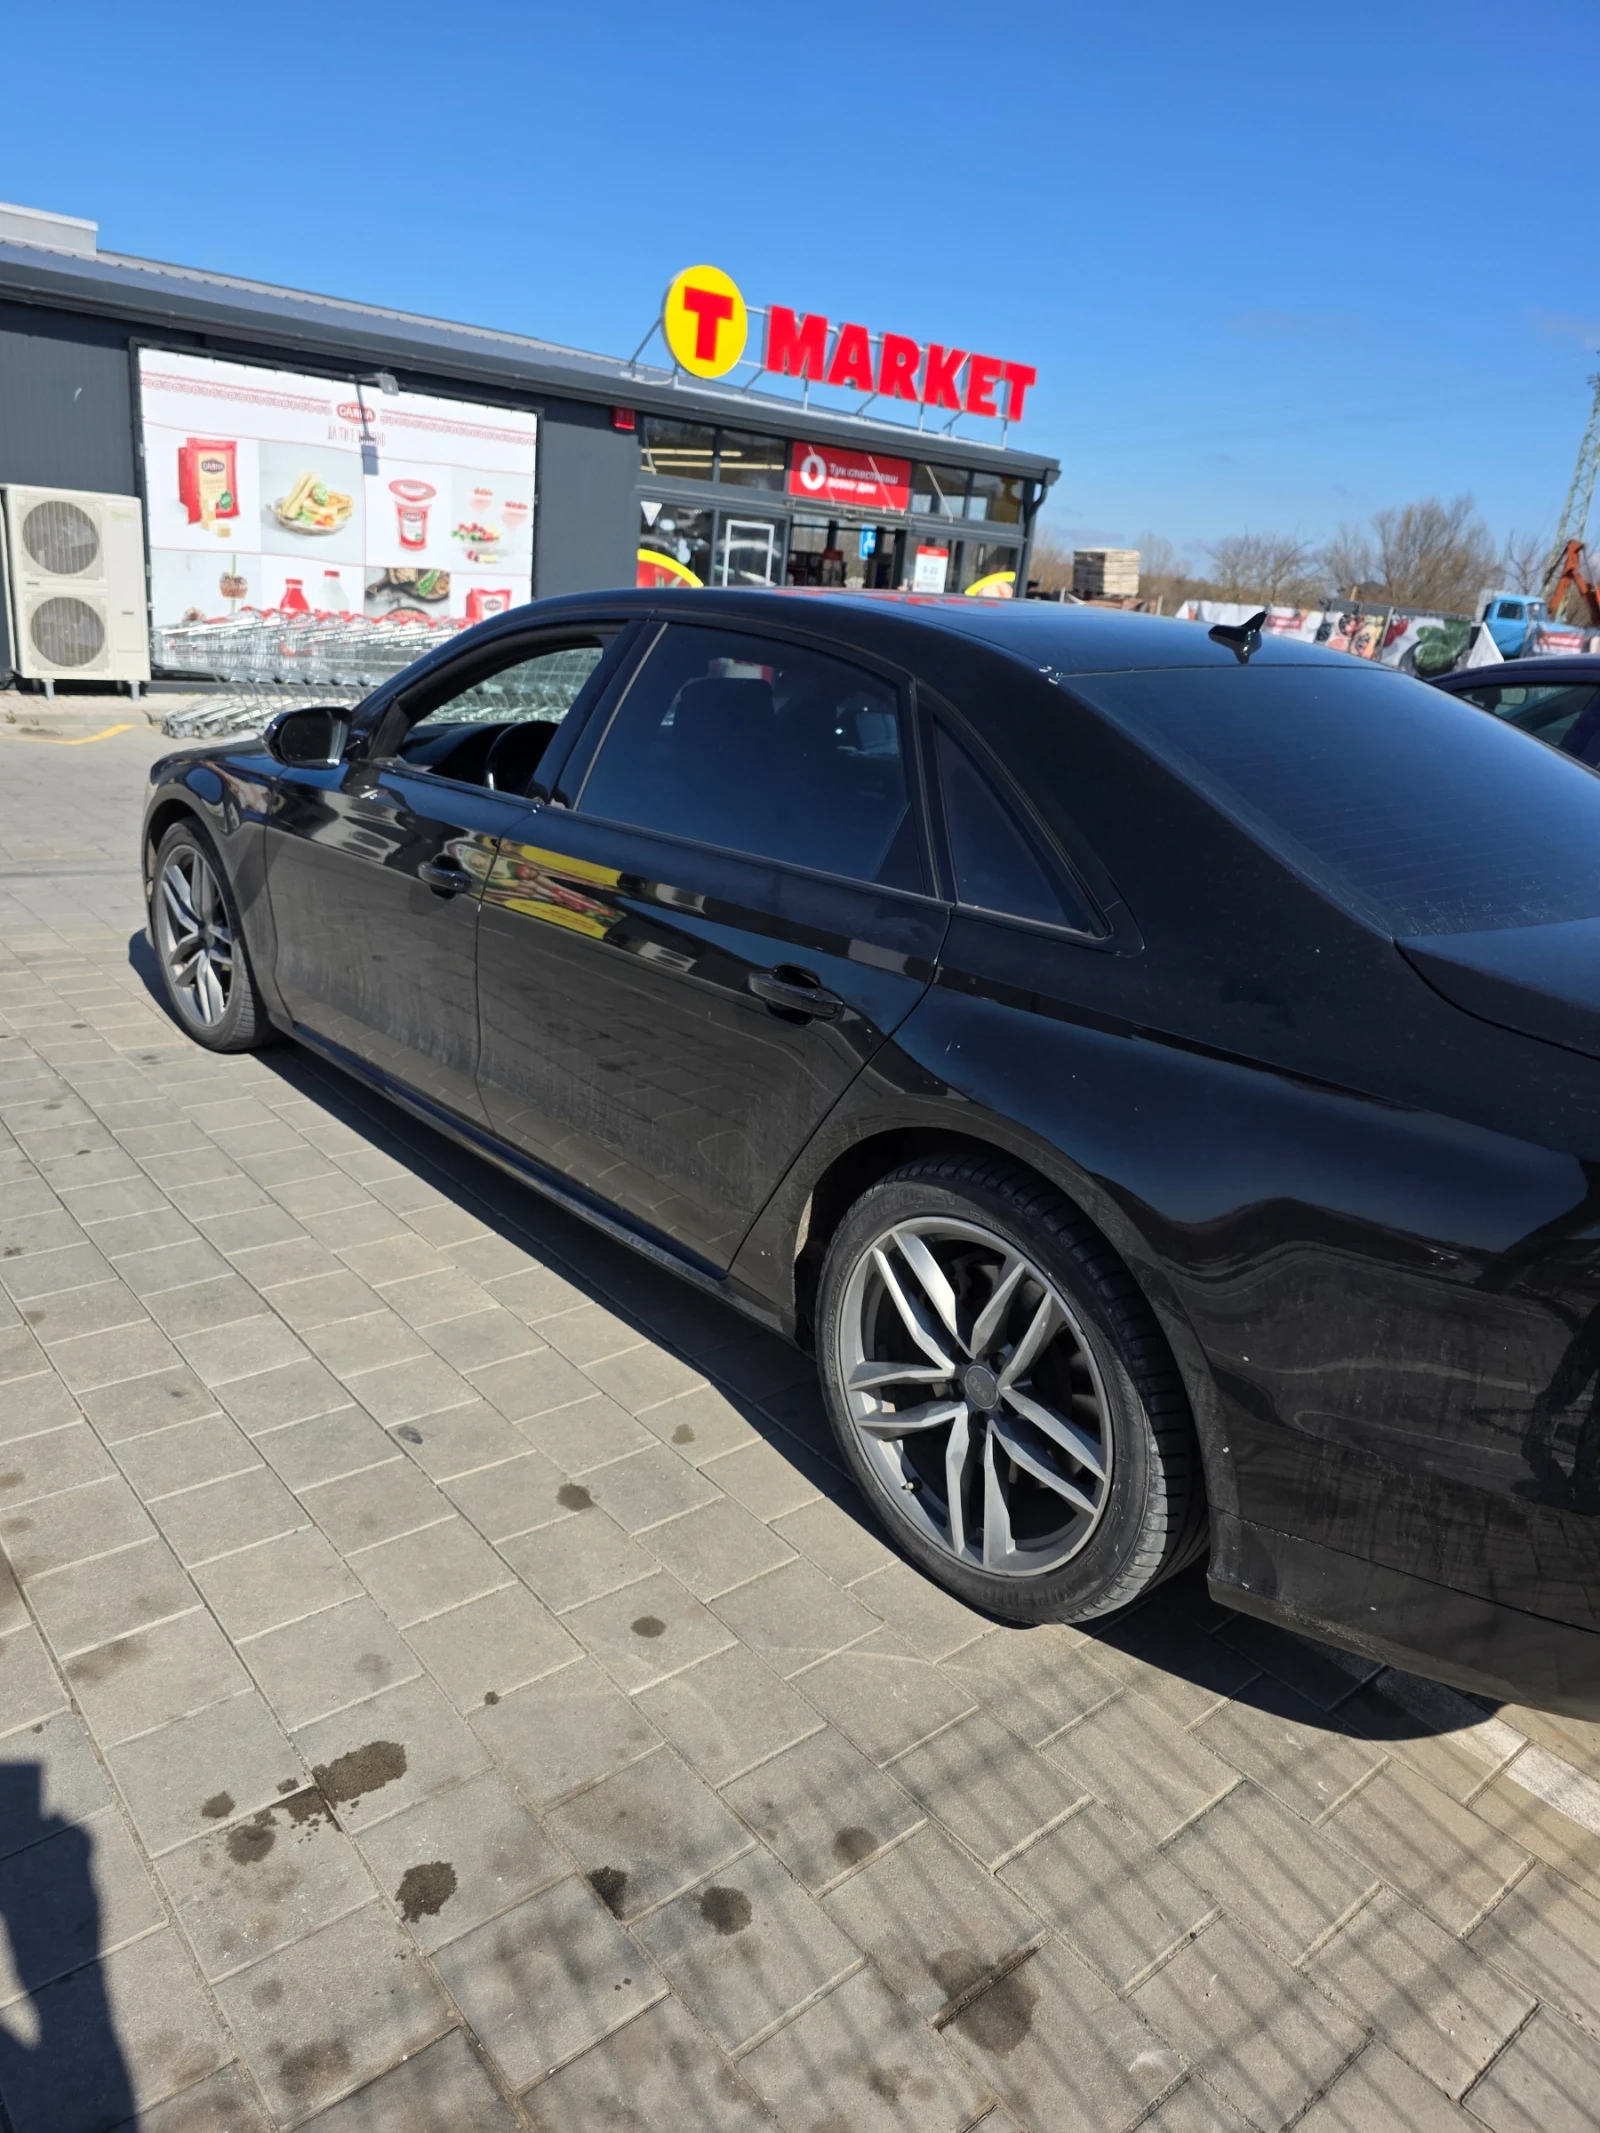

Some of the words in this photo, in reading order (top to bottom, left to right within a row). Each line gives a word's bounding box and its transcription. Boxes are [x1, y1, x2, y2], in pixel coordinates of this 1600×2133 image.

[684, 285, 734, 362] T
[765, 304, 1037, 422] MARKET
[830, 463, 847, 477] Тук
